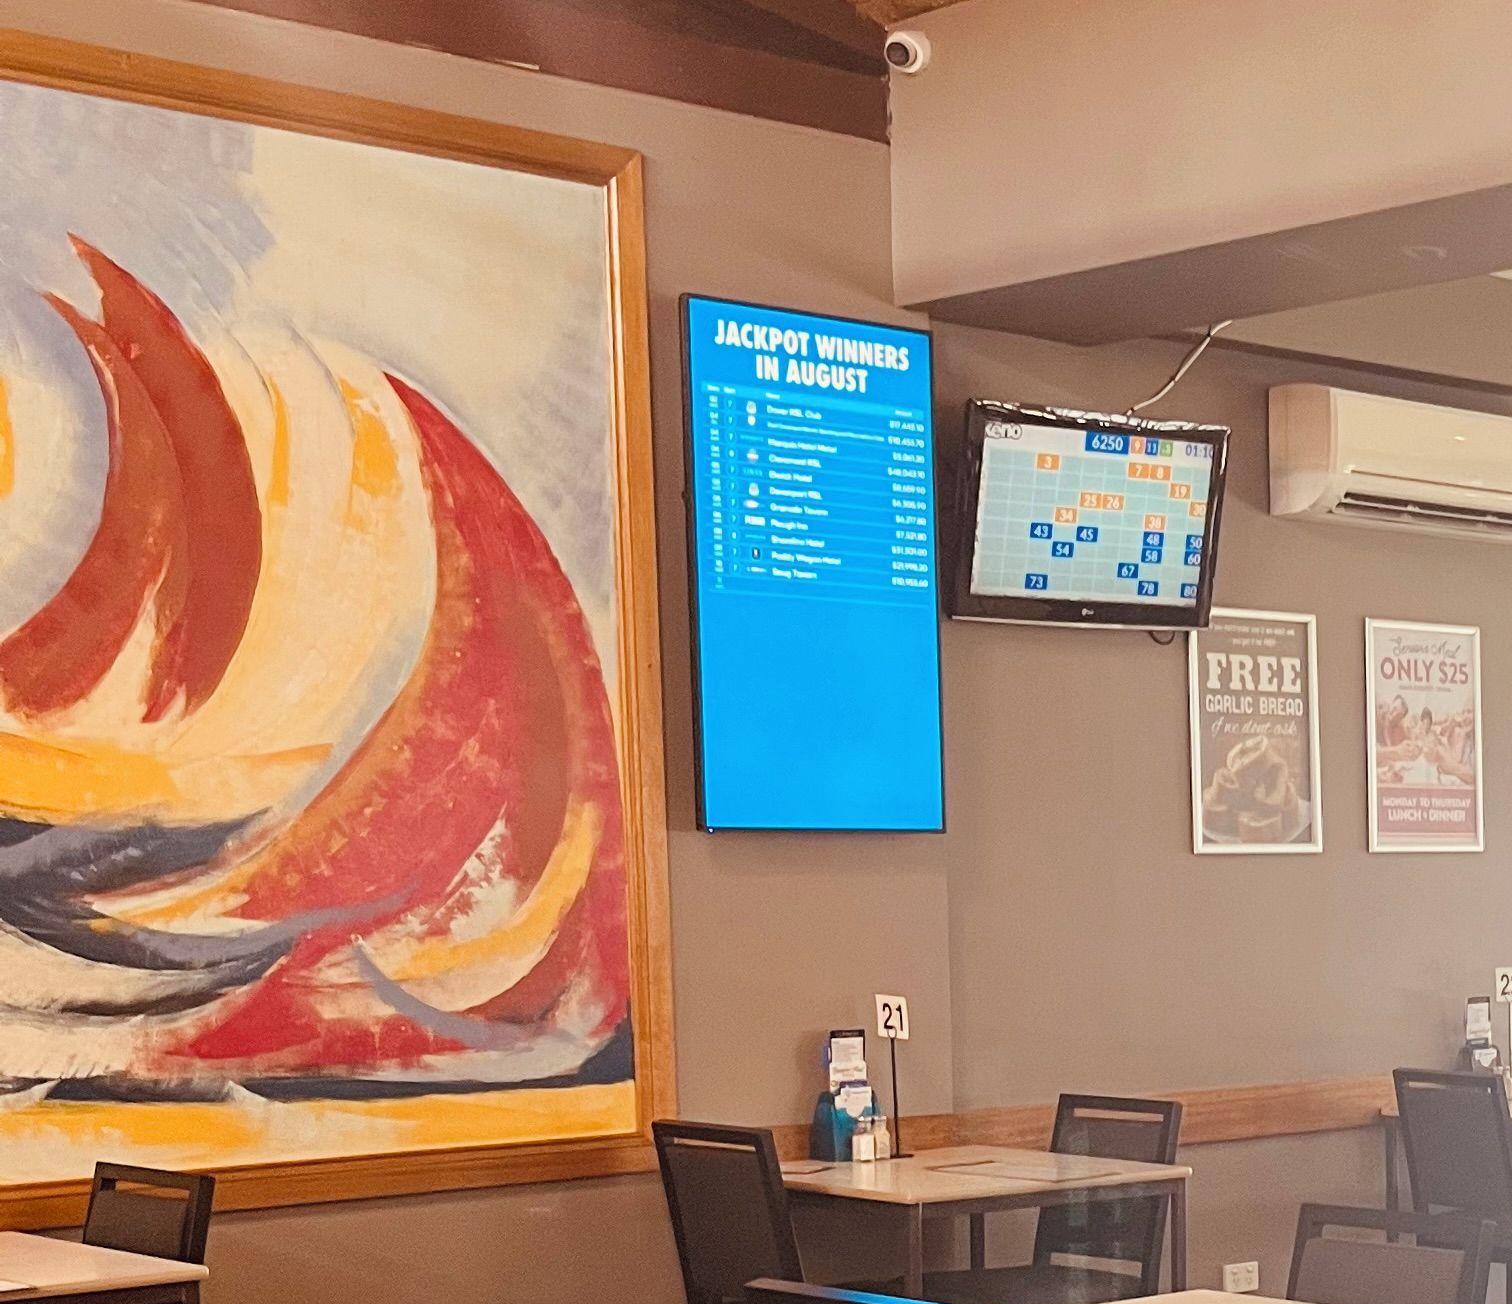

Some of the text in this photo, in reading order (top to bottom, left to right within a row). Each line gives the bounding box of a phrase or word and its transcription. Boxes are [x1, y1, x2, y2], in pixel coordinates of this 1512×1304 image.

[714, 319, 910, 371] JACKPOT WINNERS
[755, 354, 868, 393] IN AUGUST
[1092, 435, 1123, 451] 6250
[1044, 456, 1052, 469] 3
[1135, 465, 1143, 477] 7
[1156, 467, 1164, 479] 8
[1174, 485, 1187, 498] 19
[1084, 494, 1097, 507] 25
[1107, 497, 1120, 509] 26
[1060, 510, 1073, 522] 34
[1034, 525, 1048, 537] 43
[1080, 528, 1093, 541] 45
[1146, 534, 1159, 545] 48
[1190, 537, 1202, 548] 50
[1056, 544, 1070, 556] 54
[1146, 551, 1158, 562] 58
[1188, 554, 1200, 565] 60
[1122, 565, 1134, 577] 67
[1030, 576, 1043, 588] 73
[1142, 583, 1154, 594] 78
[1185, 586, 1197, 597] 80
[1206, 652, 1302, 693] FREE
[1381, 657, 1468, 684] ONLY $25
[1206, 694, 1303, 716] GARLIC BREAD
[1383, 797, 1471, 808] MONDAY TO THURSDAY
[1388, 808, 1465, 822] LUNCH DINNER
[882, 1003, 903, 1031] 21
